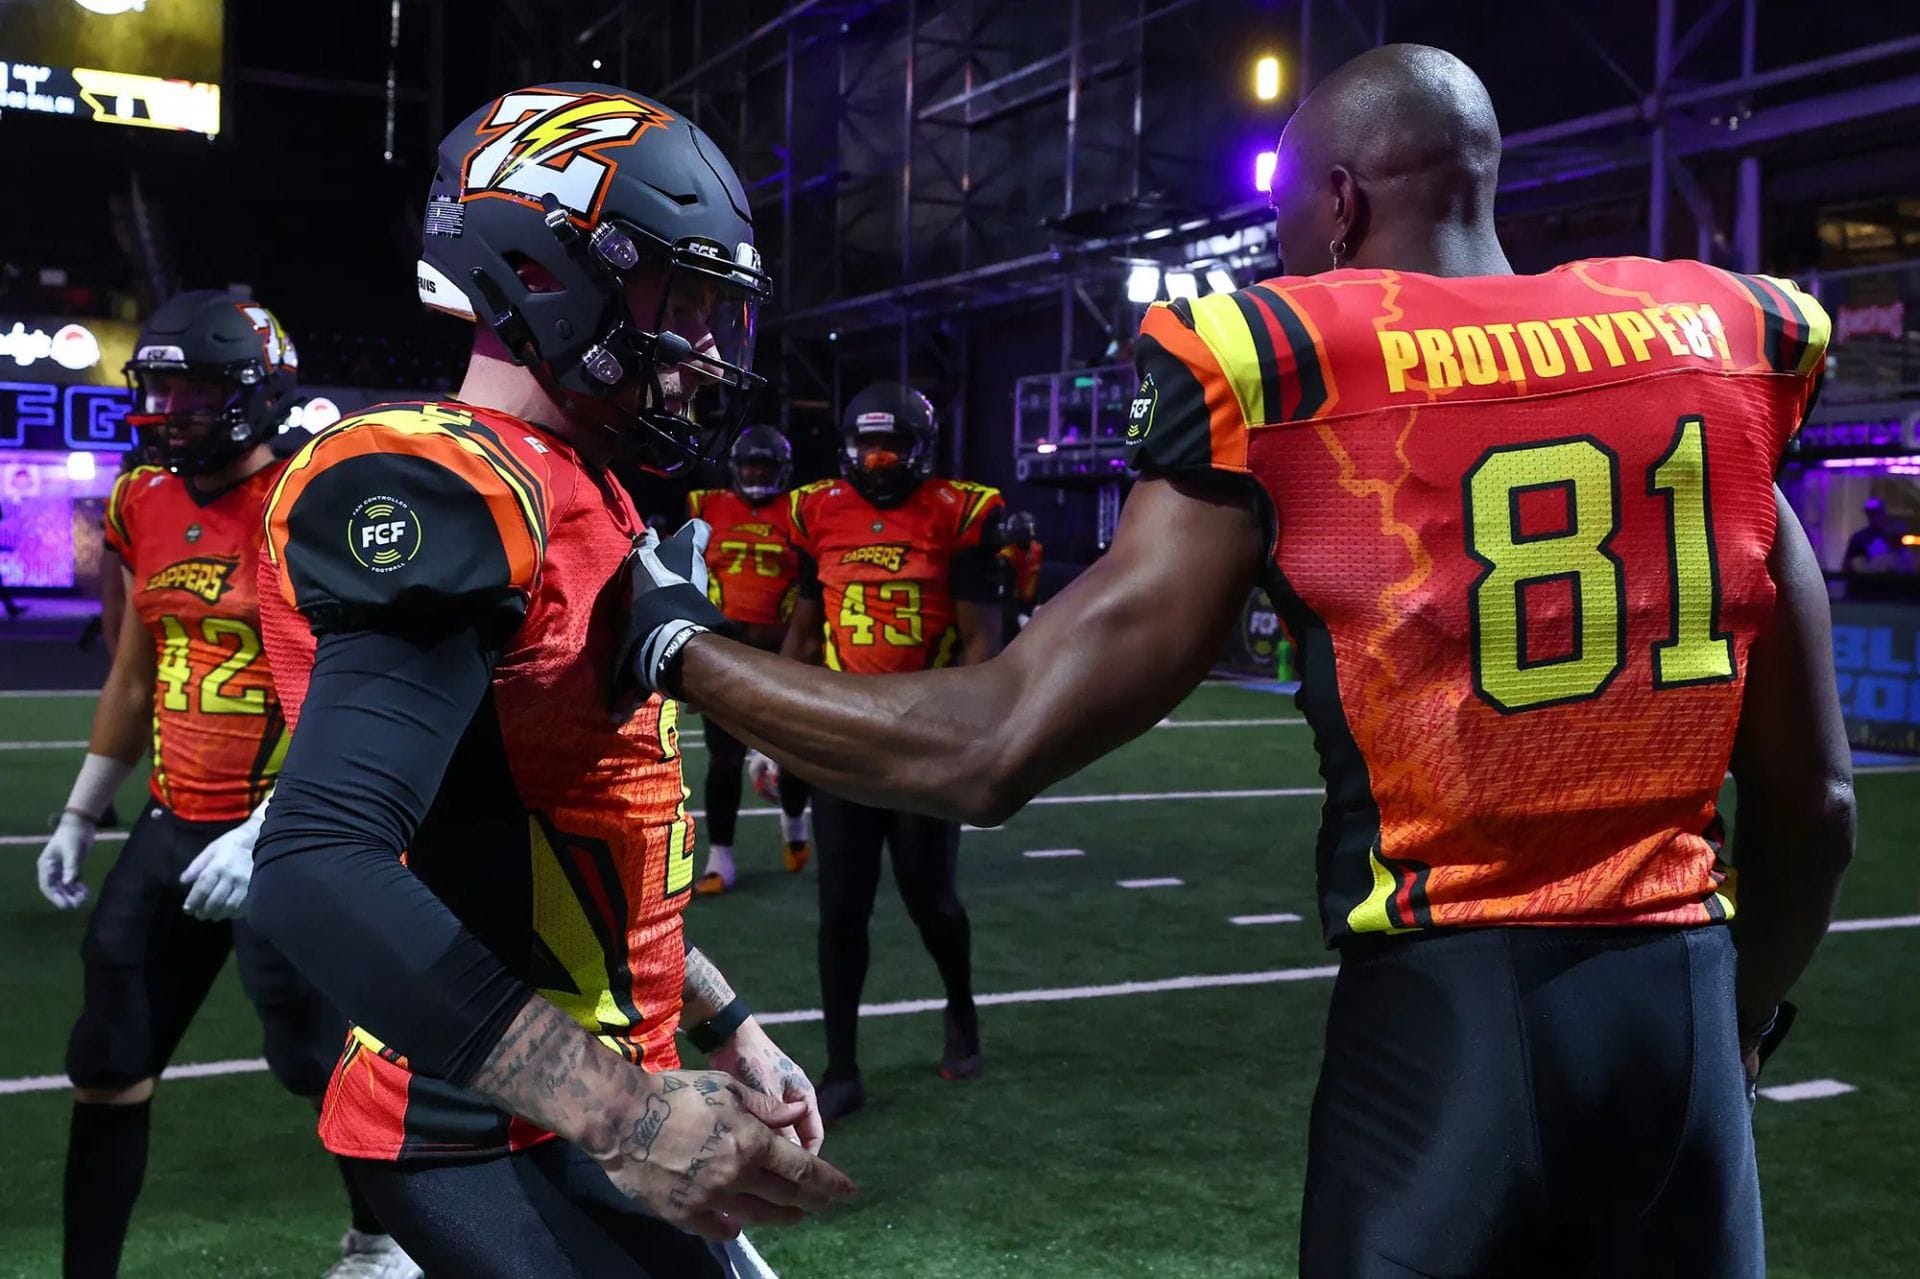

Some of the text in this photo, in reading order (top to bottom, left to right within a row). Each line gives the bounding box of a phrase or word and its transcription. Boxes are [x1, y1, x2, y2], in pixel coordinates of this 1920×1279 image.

[1376, 303, 1732, 393] PROTOTYPE81
[363, 495, 408, 509] CONTROLLED
[361, 520, 406, 548] FCF
[371, 562, 406, 573] FOOTBALL
[1462, 414, 1737, 715] 81
[840, 581, 923, 646] 43
[157, 614, 266, 714] 42
[664, 640, 679, 658] YOU
[676, 627, 695, 645] ARE
[1832, 624, 1920, 676] BL
